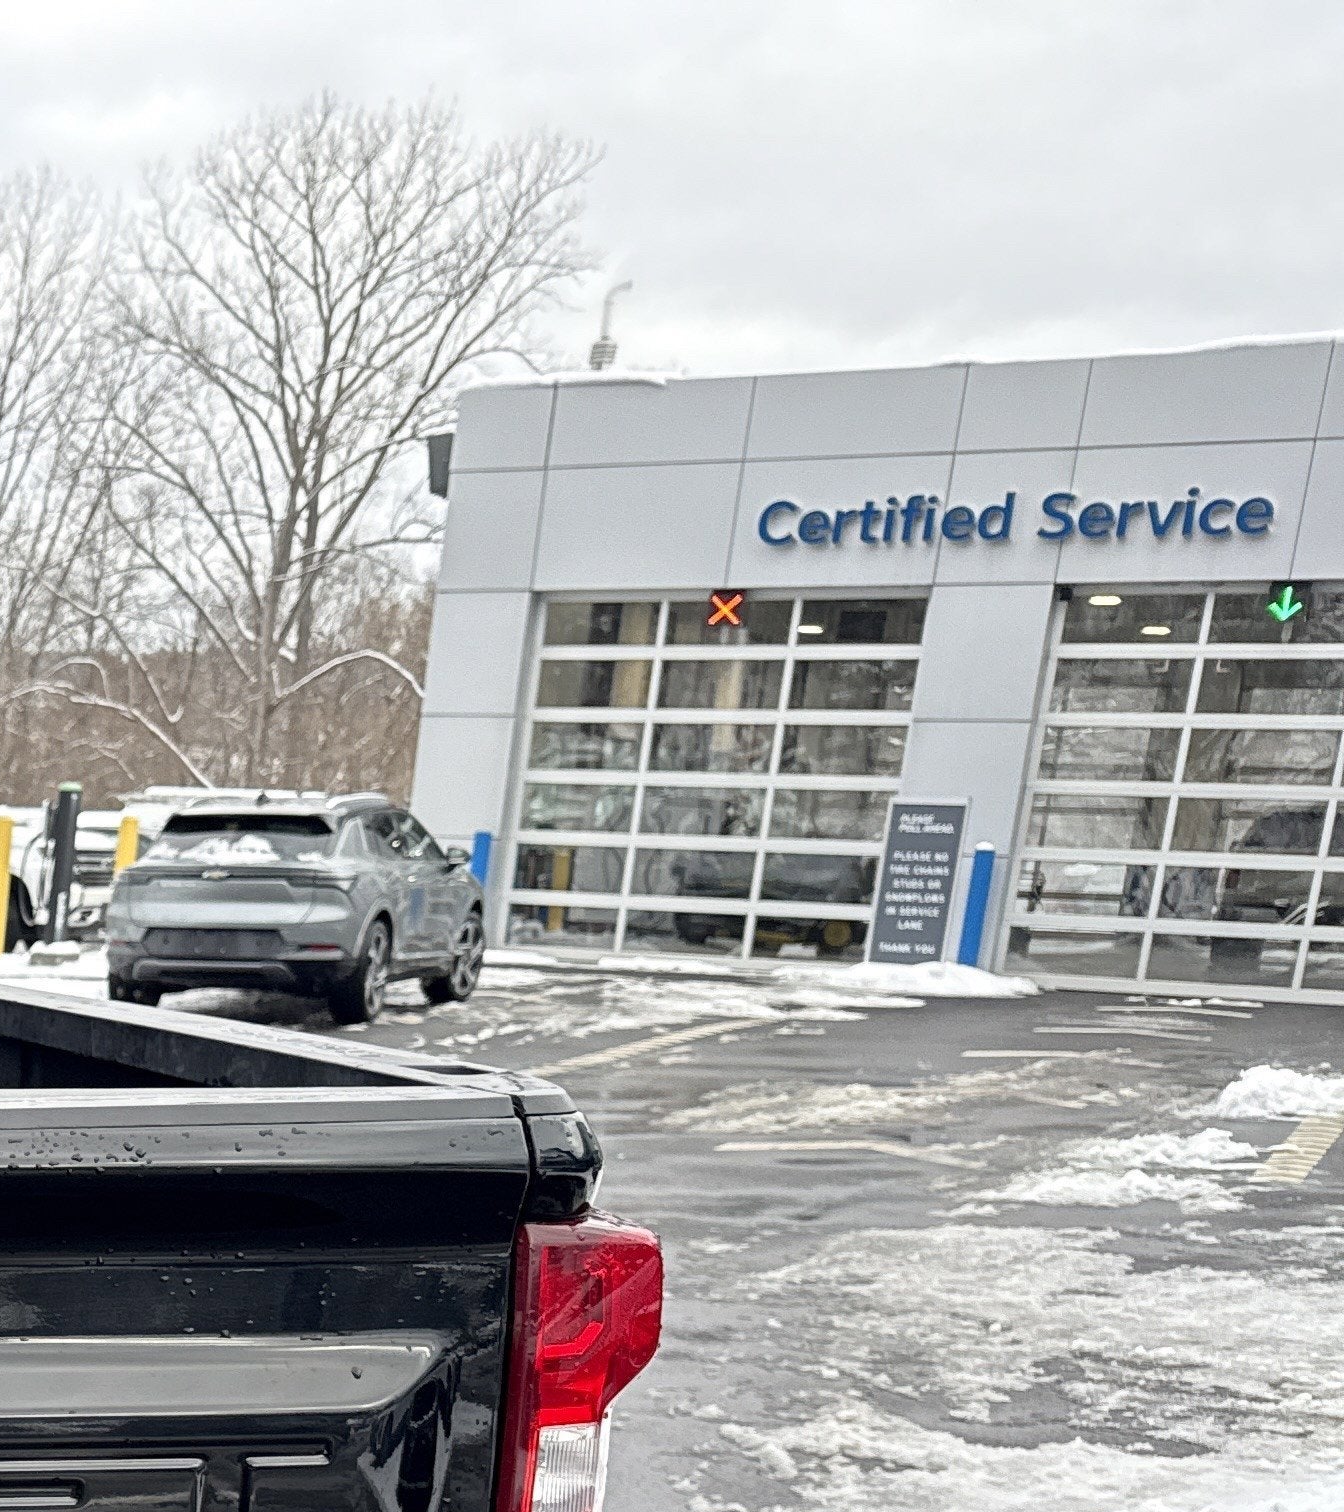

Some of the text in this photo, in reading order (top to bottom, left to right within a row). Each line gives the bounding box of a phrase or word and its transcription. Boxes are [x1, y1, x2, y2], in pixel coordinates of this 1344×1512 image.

[758, 487, 1275, 547] Certified Service
[893, 850, 950, 863] PLEASE NO
[913, 864, 950, 877] CHAINS
[898, 906, 940, 918] SERVICE
[896, 919, 924, 931] LANE
[878, 941, 936, 955] THANK YOU
